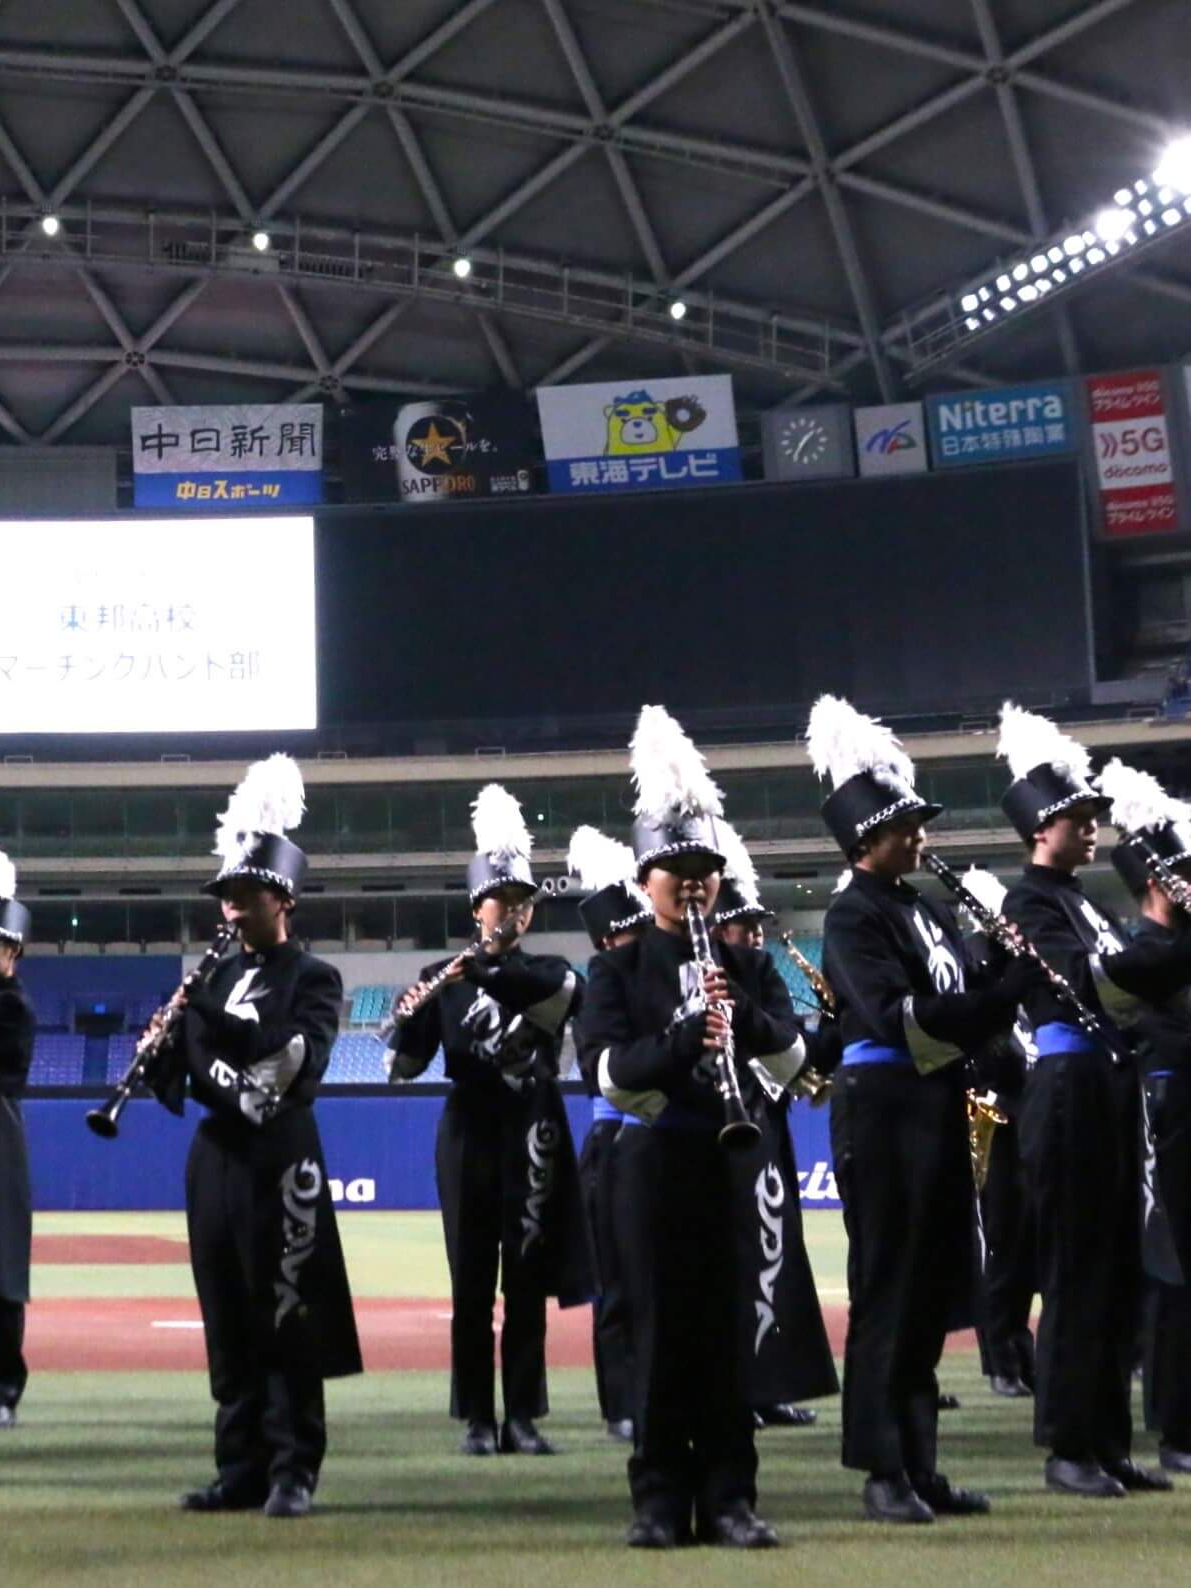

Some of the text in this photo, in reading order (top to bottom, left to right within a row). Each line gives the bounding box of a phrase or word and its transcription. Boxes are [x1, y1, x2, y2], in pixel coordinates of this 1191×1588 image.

[938, 394, 1063, 433] Niterra
[140, 422, 316, 461] 中日新聞
[1120, 427, 1164, 457] 5G
[569, 452, 720, 487] 東海テレビ
[176, 479, 281, 500] 中日スポーツ
